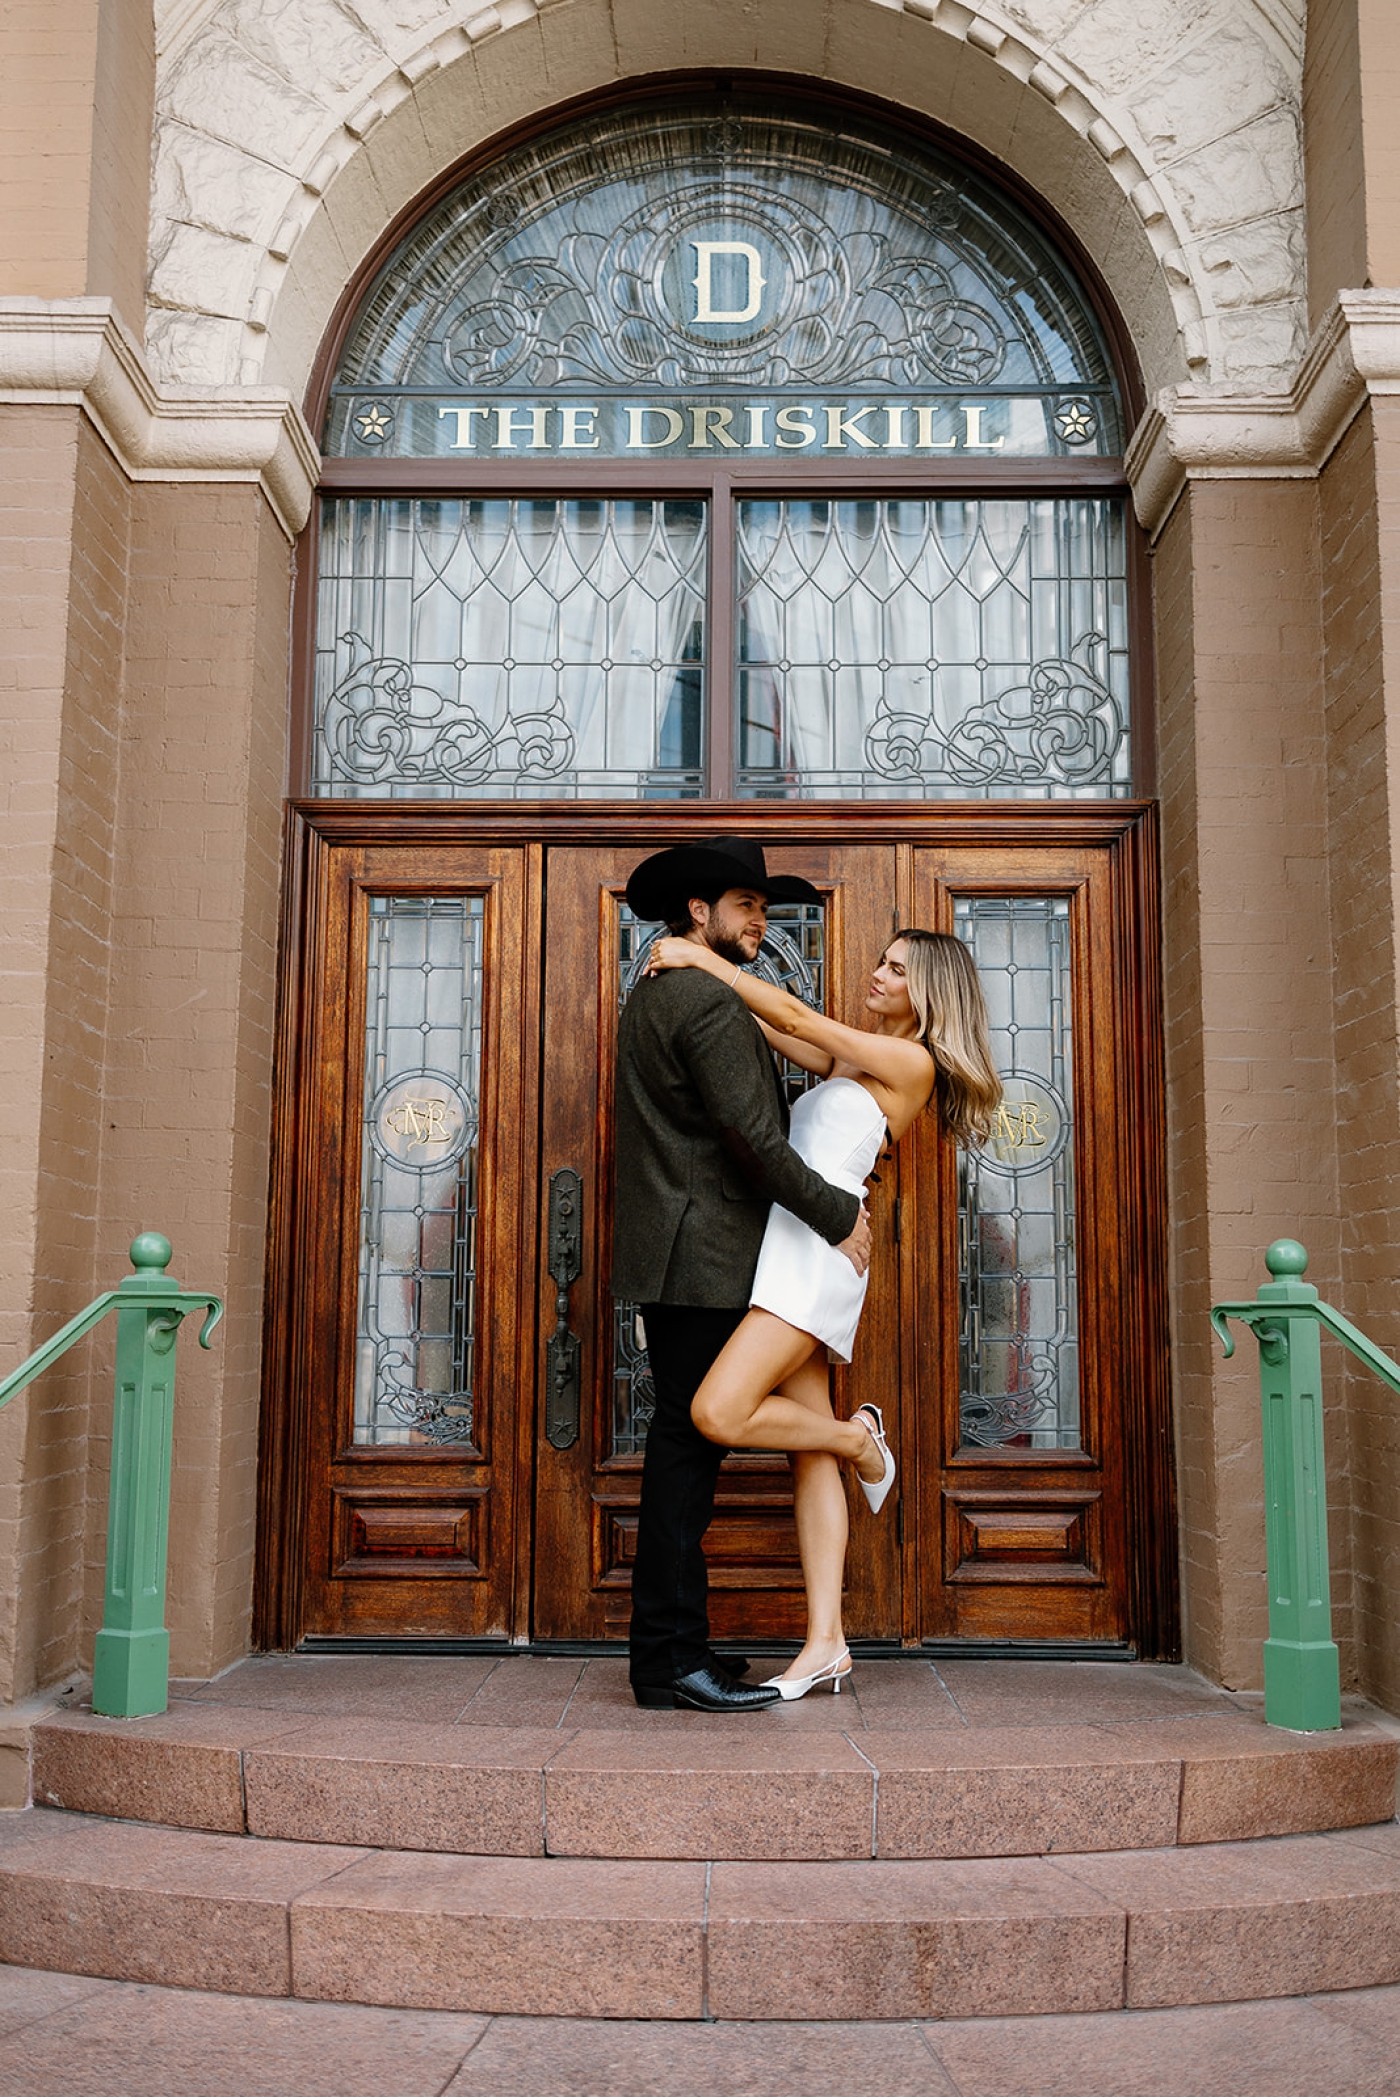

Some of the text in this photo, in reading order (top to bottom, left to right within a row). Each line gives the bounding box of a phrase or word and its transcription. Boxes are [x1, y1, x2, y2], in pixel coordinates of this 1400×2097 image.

[689, 241, 768, 323] D
[438, 406, 1006, 449] THE DRISKILL
